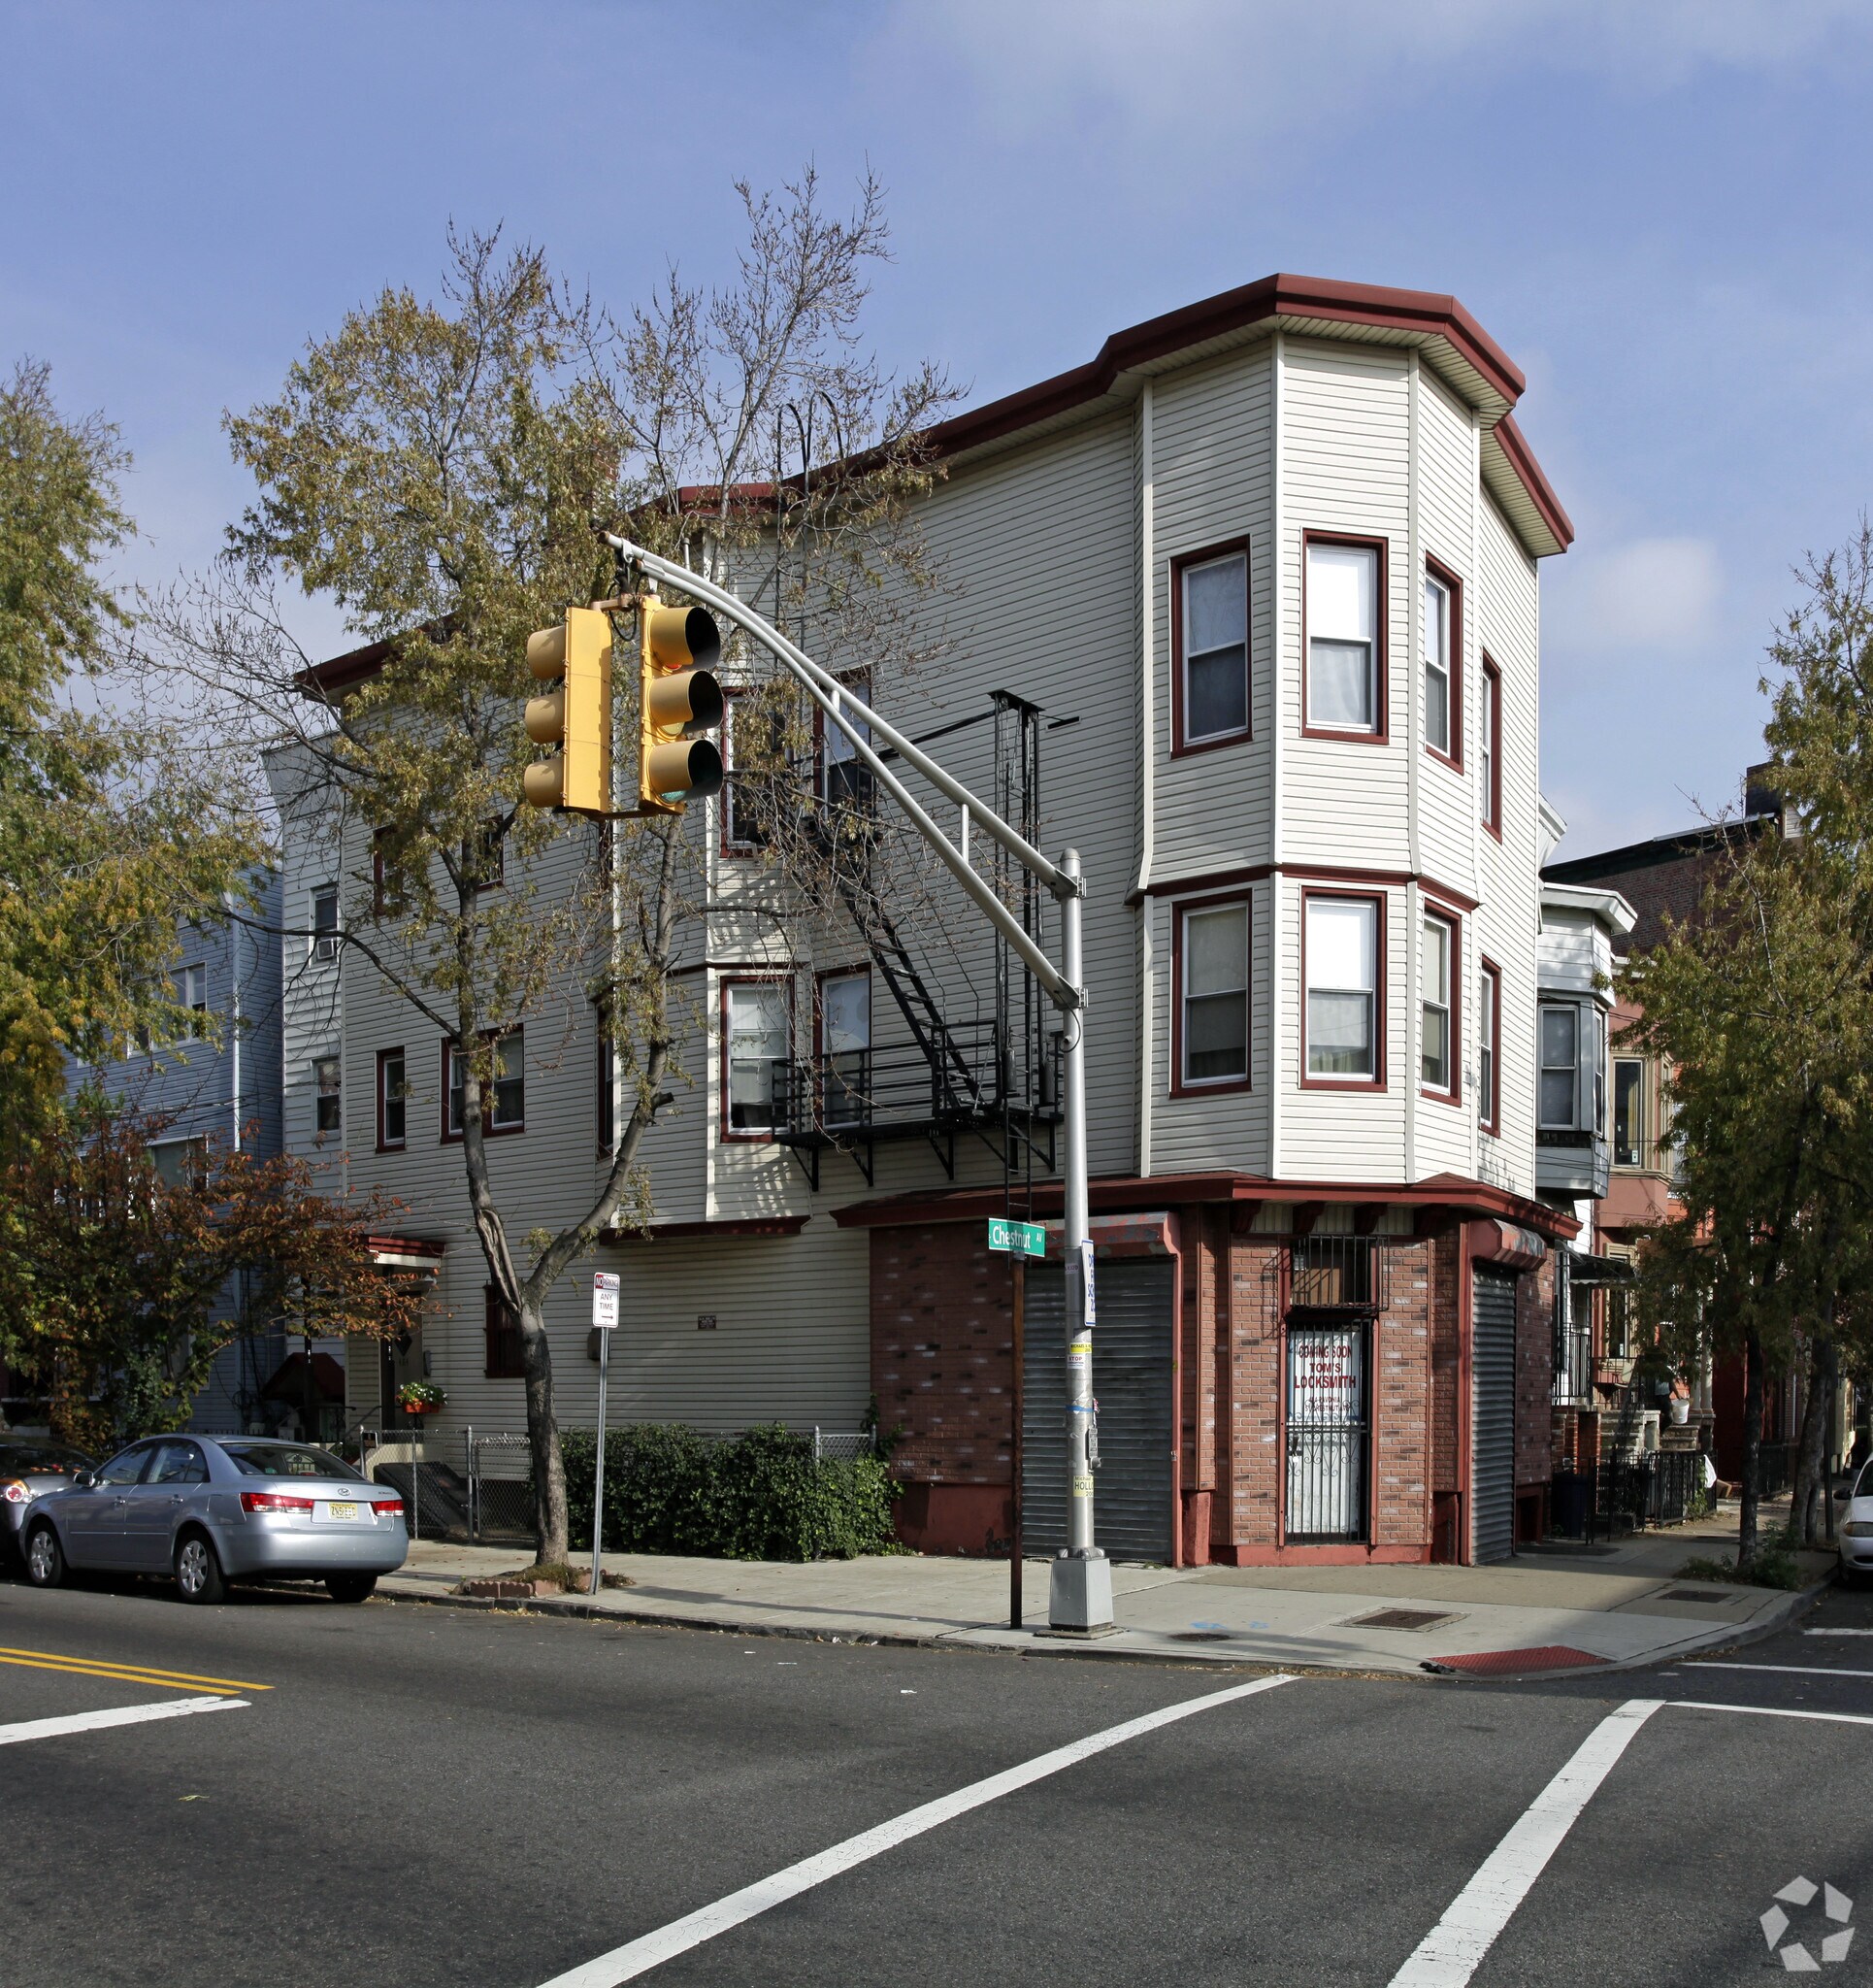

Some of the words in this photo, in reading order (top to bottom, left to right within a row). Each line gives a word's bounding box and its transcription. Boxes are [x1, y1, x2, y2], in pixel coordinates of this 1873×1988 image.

[993, 1224, 1031, 1249] Chestnut
[1036, 1233, 1042, 1242] AV
[596, 1276, 603, 1286] NO
[1298, 1345, 1329, 1358] COMING
[1332, 1345, 1352, 1358] SOON
[1309, 1363, 1341, 1373] TOM'S
[1294, 1375, 1356, 1388] LOCKSMITH
